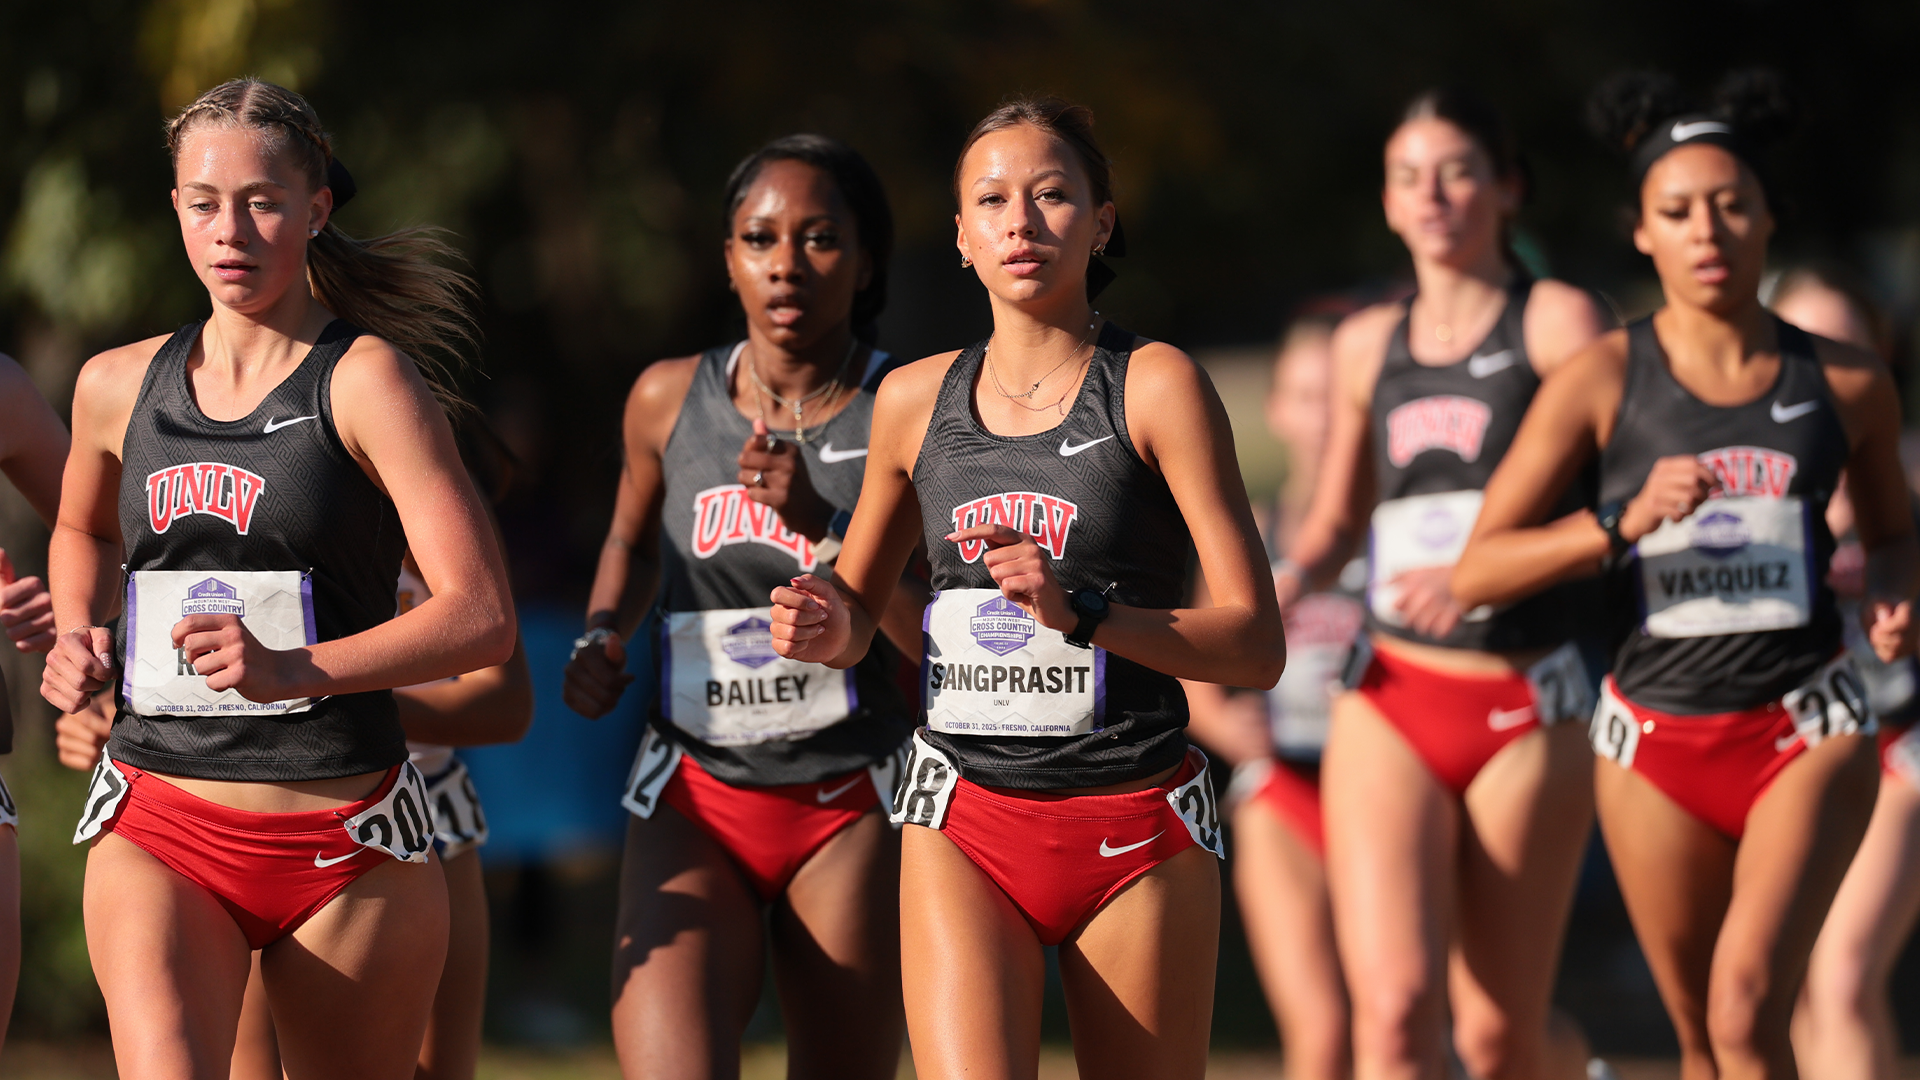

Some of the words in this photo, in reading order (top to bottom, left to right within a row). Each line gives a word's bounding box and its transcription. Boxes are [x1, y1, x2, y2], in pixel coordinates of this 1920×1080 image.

[146, 462, 265, 535] UNLV
[952, 491, 1084, 564] UNLV
[1658, 562, 1791, 598] VASQUEZ
[184, 604, 206, 613] CROSS
[207, 604, 242, 613] COUNTRY
[972, 622, 995, 631] CROSS
[996, 622, 1032, 633] COUNTRY
[706, 674, 810, 707] BAILEY
[930, 662, 1090, 694] SANGPRASIT
[155, 704, 184, 712] OCTOBER
[185, 704, 197, 713] 31,
[197, 704, 214, 712] 2025
[218, 703, 247, 712] FRESNO,
[247, 703, 287, 711] CALIFORNIA
[945, 721, 971, 730] OCTOBER
[971, 722, 980, 731] 31,
[981, 723, 997, 731] 2025
[1001, 724, 1029, 732] FRESNO,
[1030, 724, 1071, 732] CALIFORNIA
